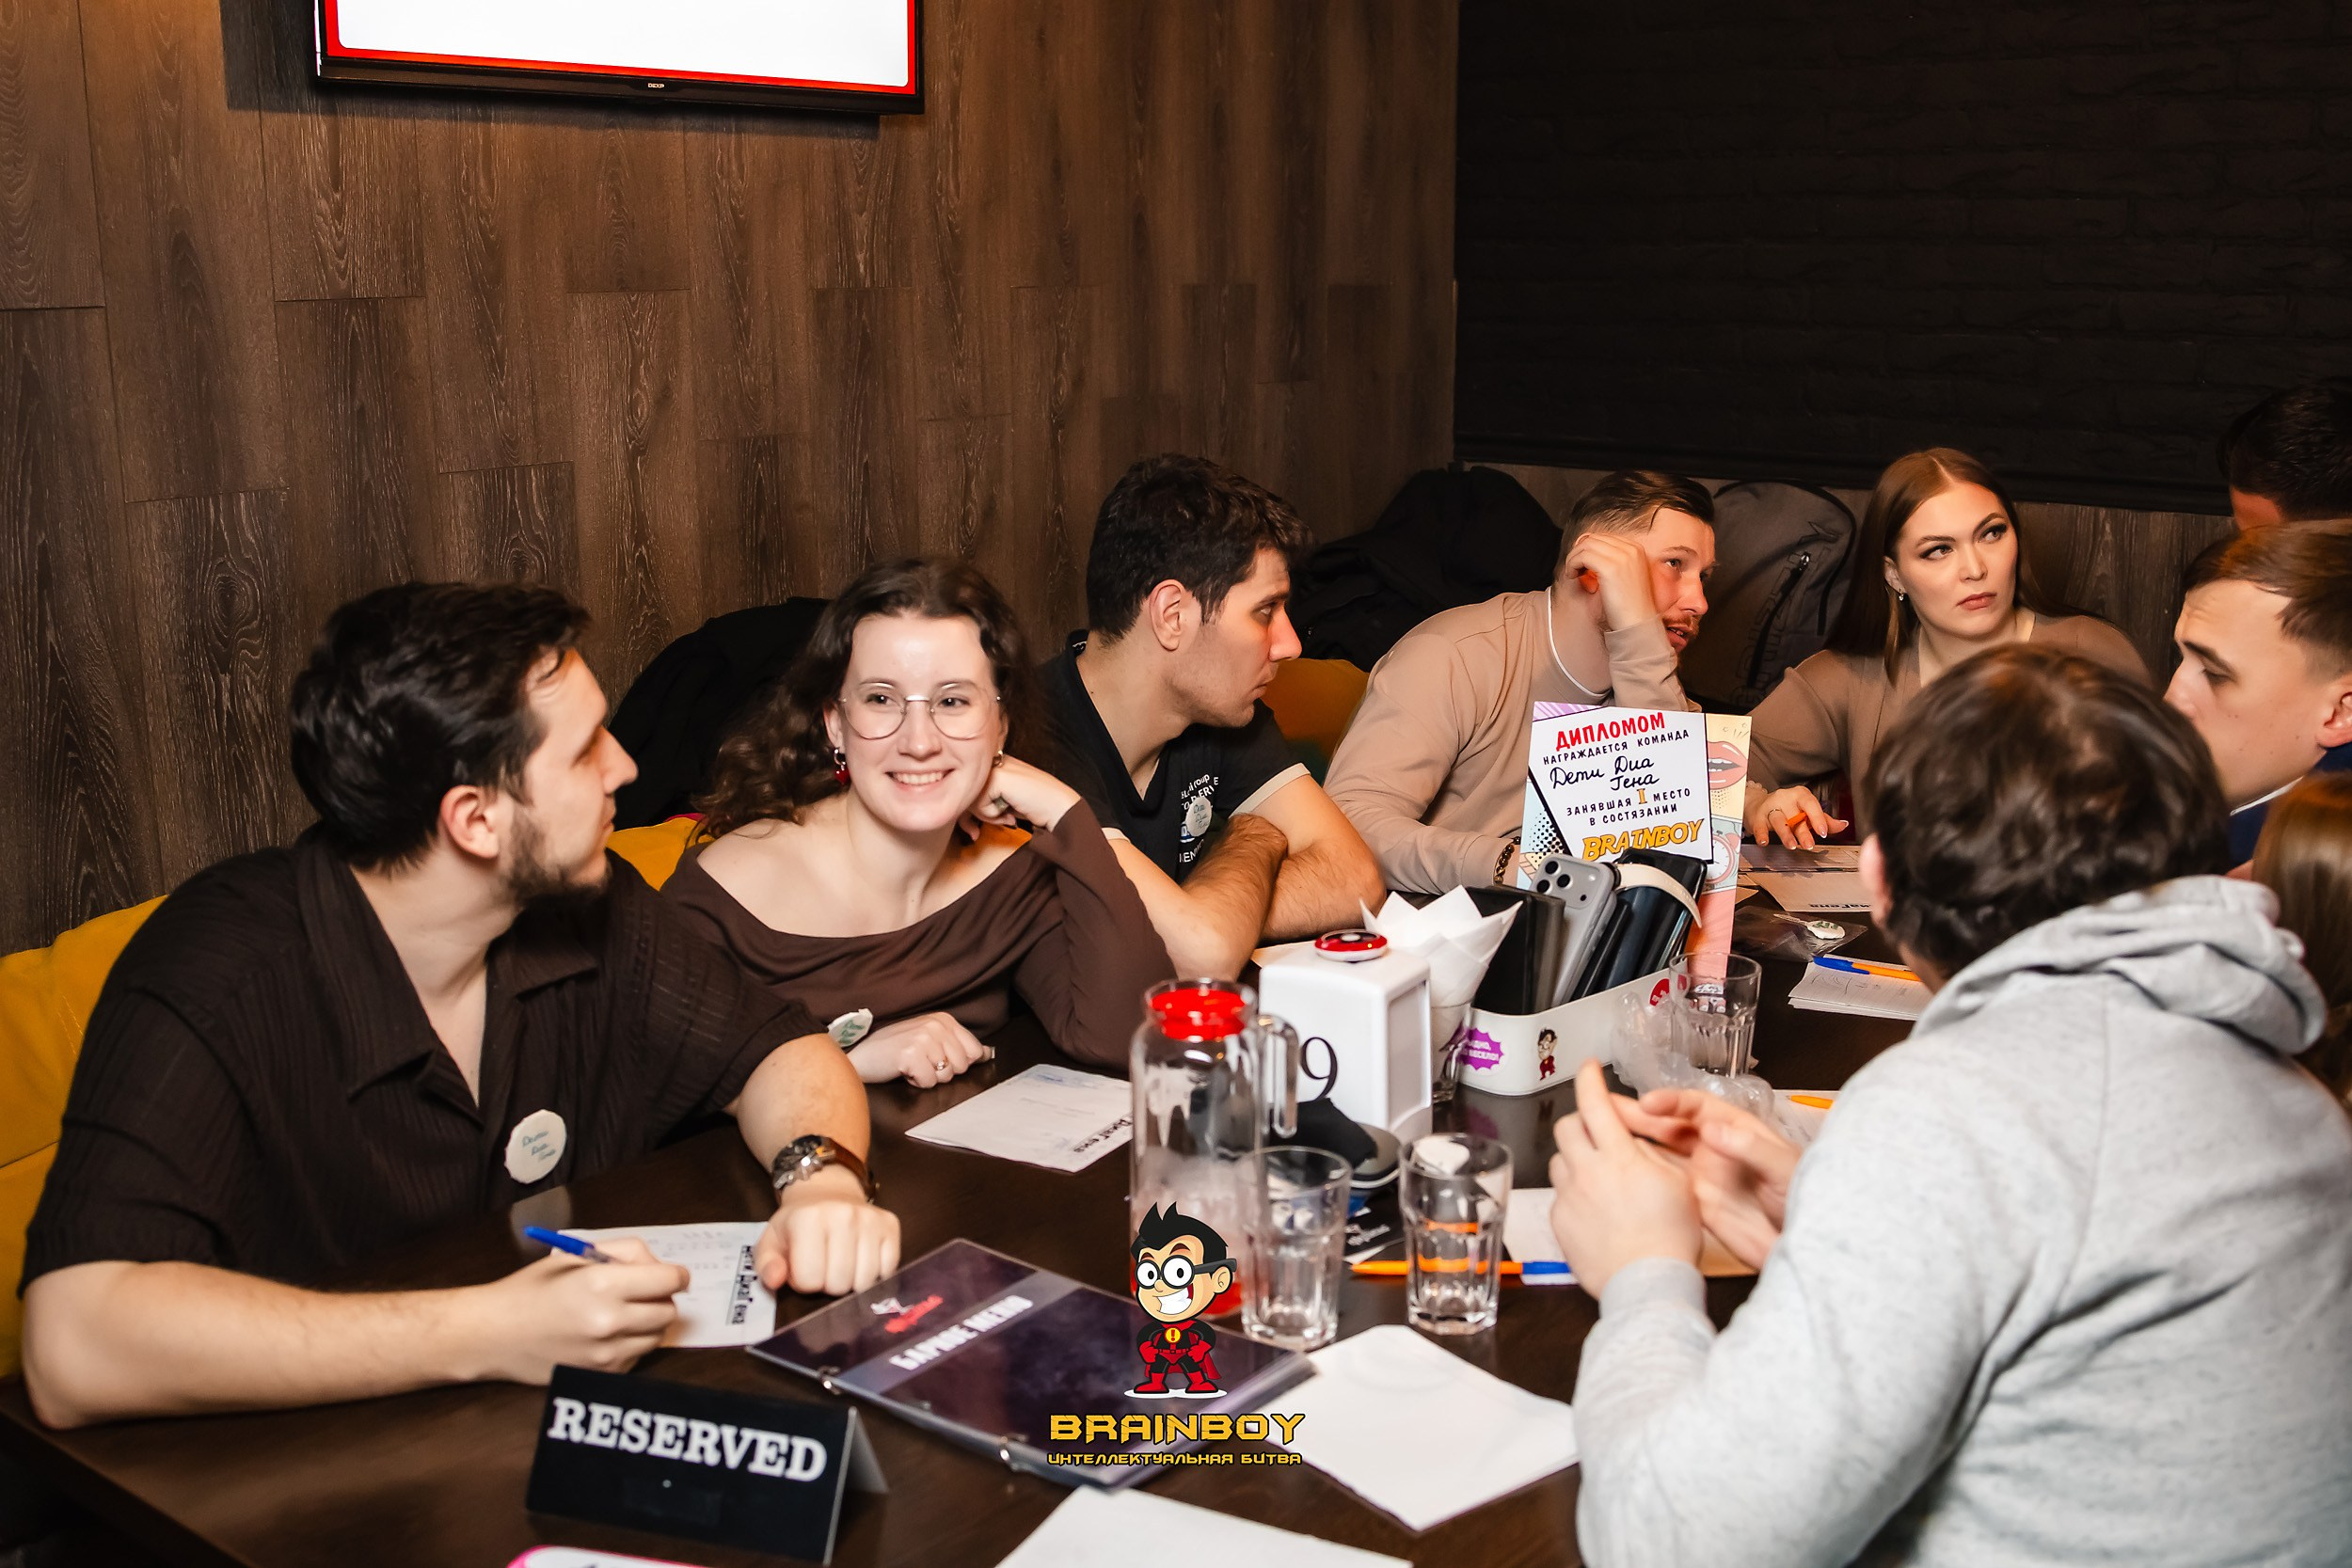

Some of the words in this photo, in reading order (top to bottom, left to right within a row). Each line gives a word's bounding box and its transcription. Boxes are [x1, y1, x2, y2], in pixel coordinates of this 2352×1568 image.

[1543, 741, 1629, 766] НАГРАЖДАЕТСЯ
[1637, 729, 1690, 748] КОМАНДА
[1555, 712, 1665, 752] ДИПЛОМОМ
[1549, 766, 1605, 789] Дети
[1614, 755, 1655, 775] Диа
[1566, 798, 1632, 816] ЗАНЯВШАЯ
[1653, 787, 1692, 802] МЕСТО
[1589, 816, 1596, 827] В
[1602, 803, 1678, 825] СОСТЯЗАНИИ
[1582, 817, 1706, 862] BRAINBOY
[1300, 1037, 1339, 1101] 9
[548, 1397, 828, 1482] RESERVED
